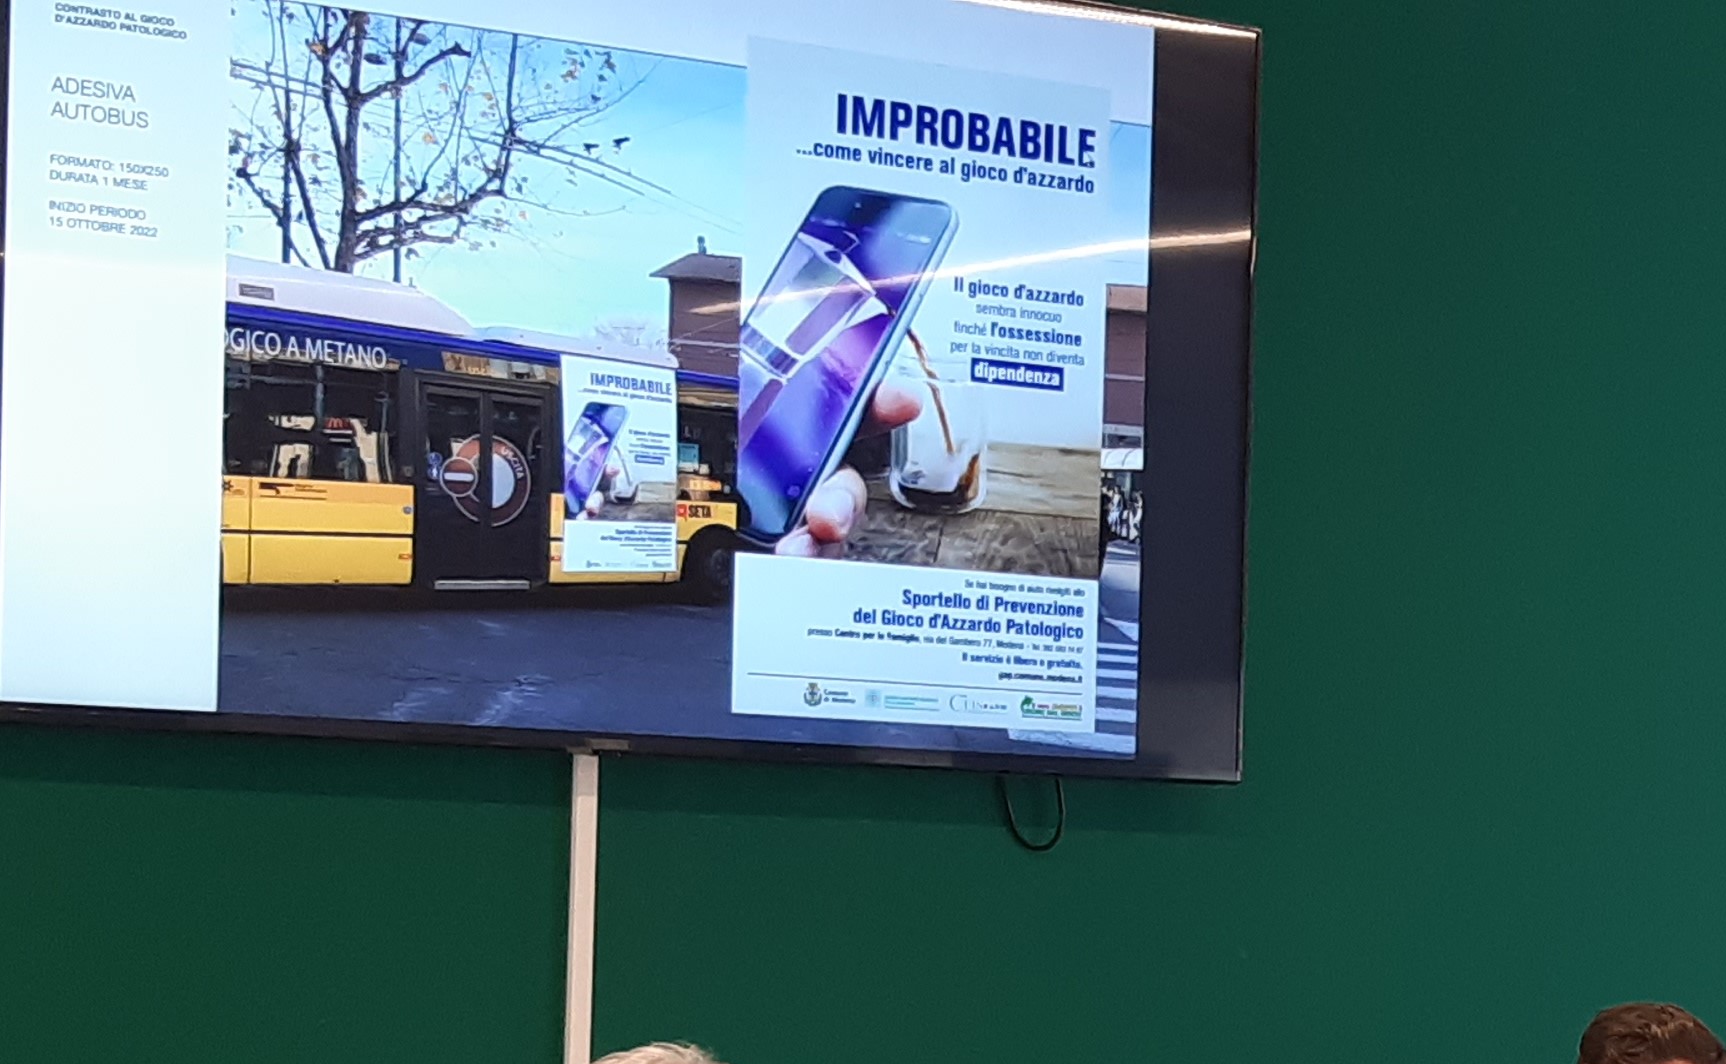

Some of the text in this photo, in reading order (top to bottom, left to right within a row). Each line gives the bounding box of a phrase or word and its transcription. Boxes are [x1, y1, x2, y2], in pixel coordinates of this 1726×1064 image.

[54, 14, 187, 39] D'AZZARDO PATOLOGICO
[55, 2, 175, 26] CONTRASTO AL GIOCO
[51, 76, 136, 102] ADESIVA
[50, 101, 149, 128] AUTOBUS
[837, 93, 1096, 168] IMPROBABILE
[49, 170, 148, 190] DURATA 1 MESE
[796, 142, 1095, 193] ...come vincere al gioco d'azzardo
[49, 200, 146, 220] INIZIO PERIODO
[49, 216, 158, 238] 15 OTTOBRE 2022
[954, 276, 1084, 306] Il gioco d'azzardo
[976, 304, 1062, 323] sembra innocuo
[990, 322, 1082, 347] l'ossessione
[286, 336, 299, 357] A
[305, 338, 387, 369] METANO
[950, 341, 968, 354] per
[985, 344, 1020, 359] vincita
[1024, 350, 1044, 361] non
[1046, 351, 1085, 366] diventa
[590, 373, 673, 396] IMPROBABILE
[974, 362, 1060, 386] dipendenza
[688, 504, 712, 519] SETA
[902, 589, 1084, 618] Sportello di Prevenzione
[853, 608, 1084, 642] del Gioco d'Azzardo Patologico
